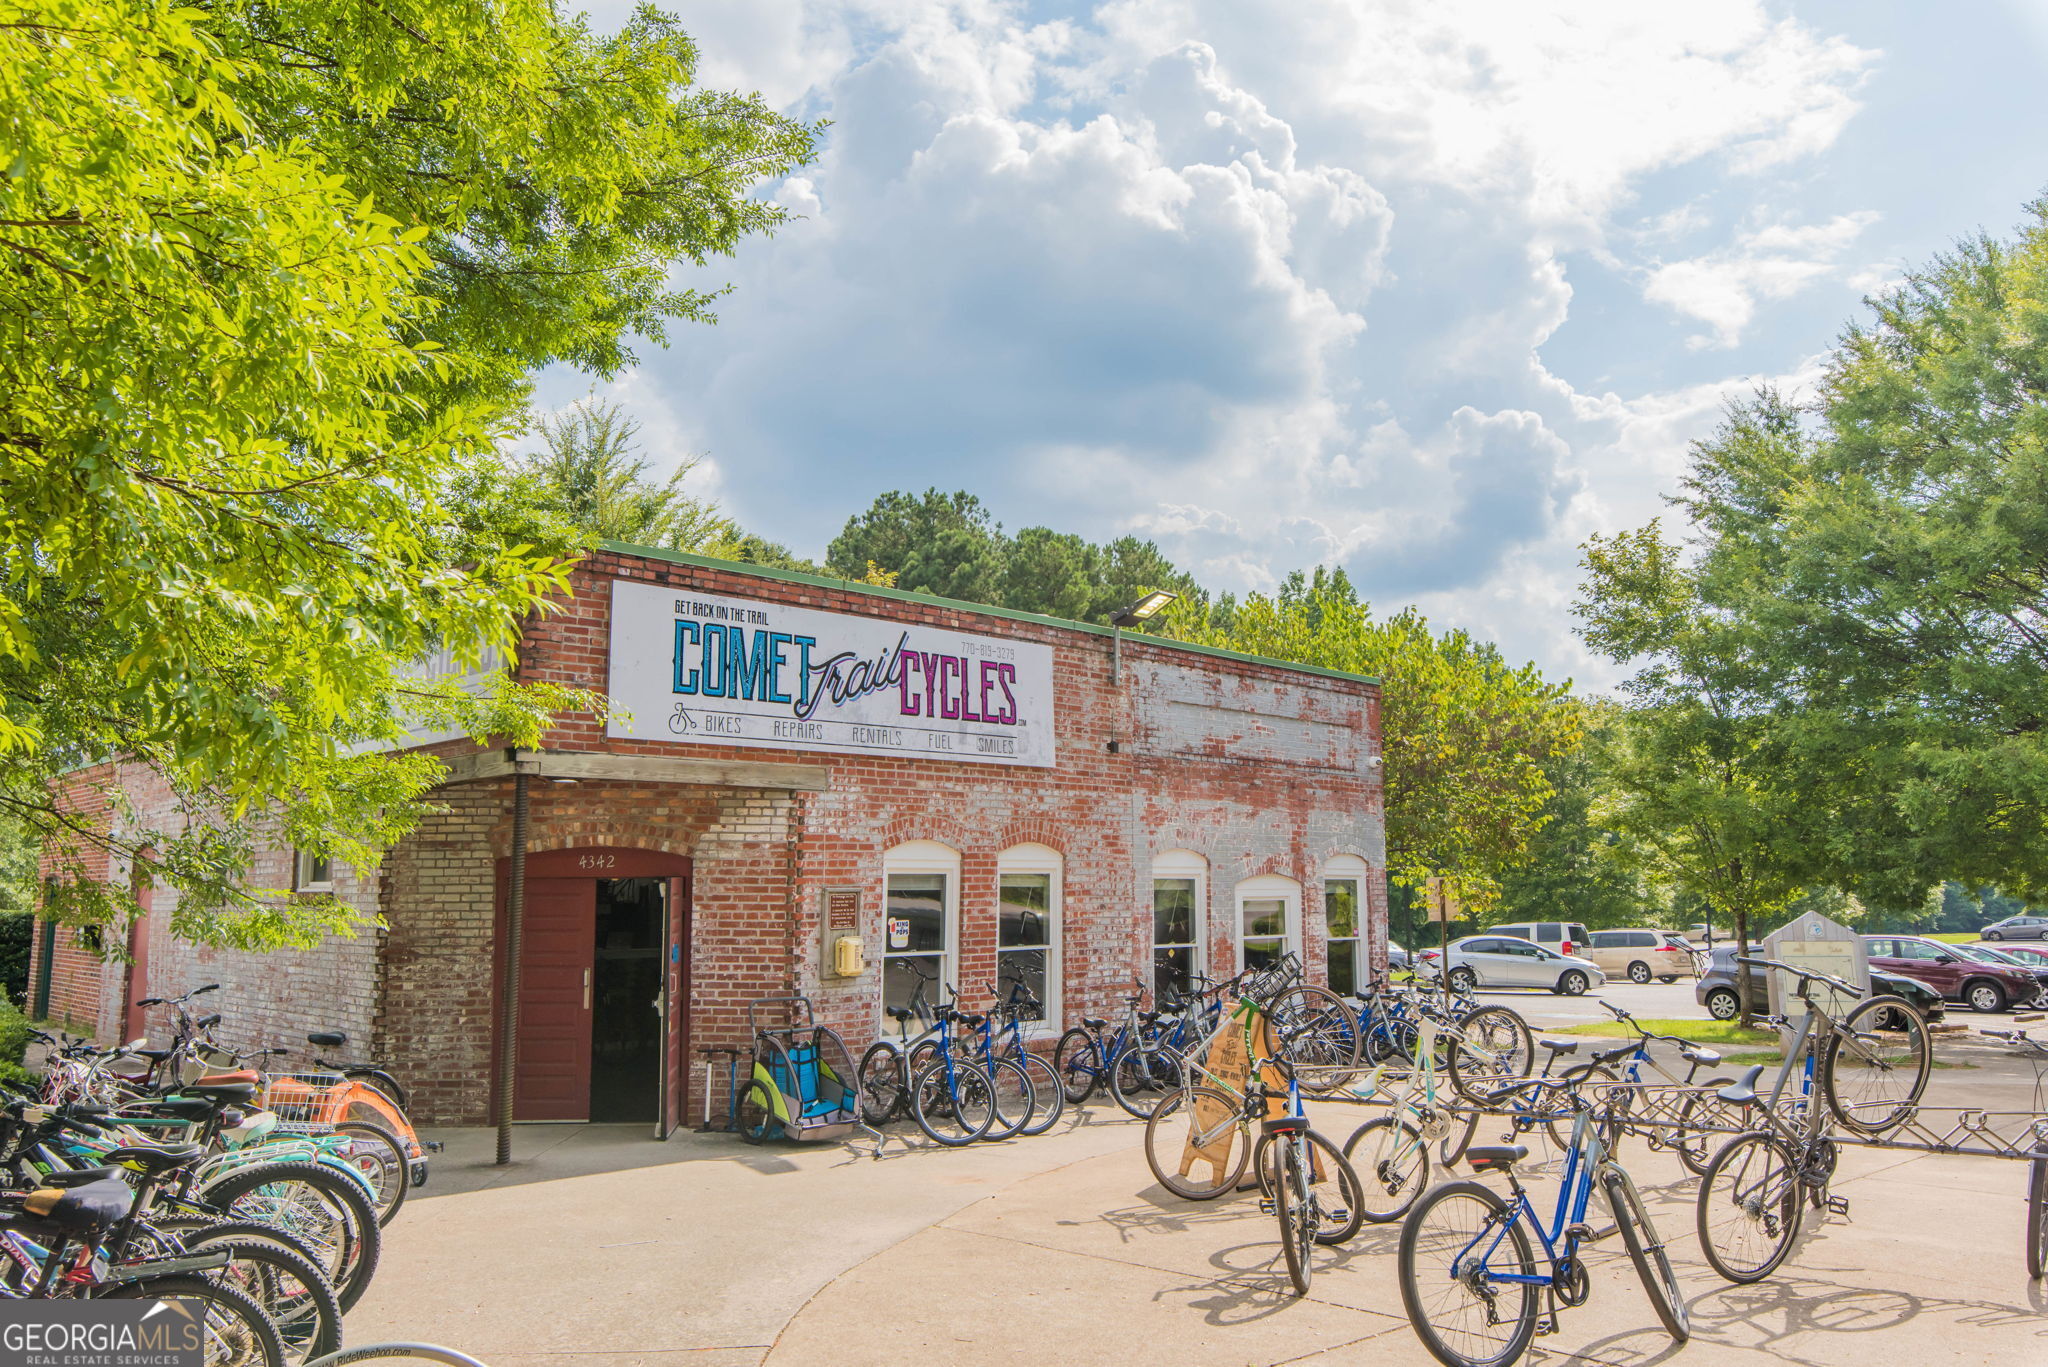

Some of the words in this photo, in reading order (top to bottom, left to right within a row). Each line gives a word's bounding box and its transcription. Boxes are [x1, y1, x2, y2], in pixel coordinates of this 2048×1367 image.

[674, 599, 691, 614] GET
[692, 602, 714, 618] BACK
[716, 605, 728, 620] ON
[730, 607, 745, 623] THE
[747, 610, 769, 626] TRAIL
[961, 641, 1015, 661] 770-819-3279
[672, 618, 816, 706] COMET
[794, 631, 909, 721] Trail
[900, 649, 1017, 726] CYCLES
[705, 715, 741, 734] BIKES
[774, 720, 823, 740] REPAIRS
[852, 727, 901, 745] RENTALS
[928, 733, 953, 750] FUEL
[978, 737, 1014, 754] SMILES
[579, 854, 615, 869] 4342
